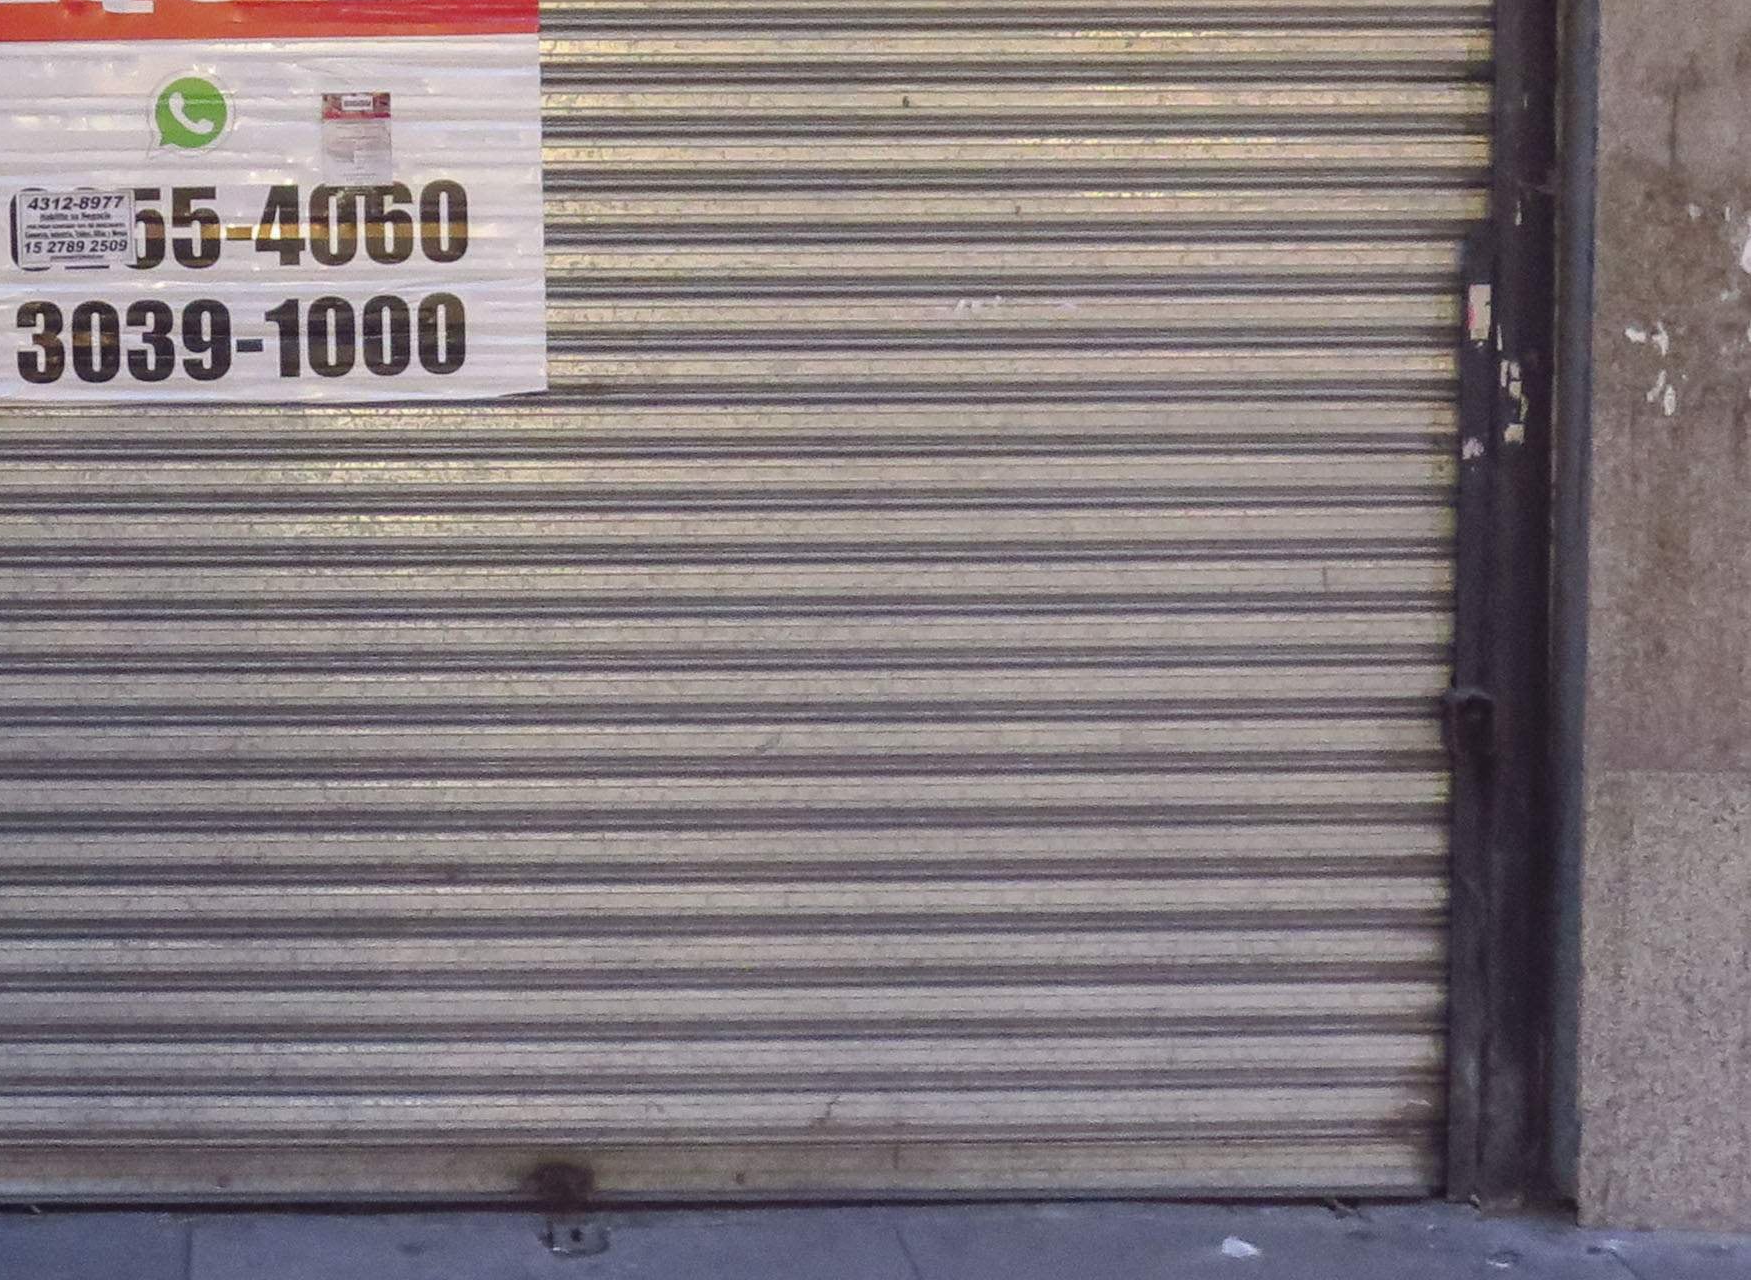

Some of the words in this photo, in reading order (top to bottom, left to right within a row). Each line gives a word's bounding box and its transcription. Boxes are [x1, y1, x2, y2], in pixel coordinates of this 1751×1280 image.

[27, 195, 124, 211] 4312-8977
[24, 241, 43, 254] 15
[46, 241, 85, 253] 2789
[89, 239, 128, 252] 2509
[16, 292, 466, 384] 3039-1000
